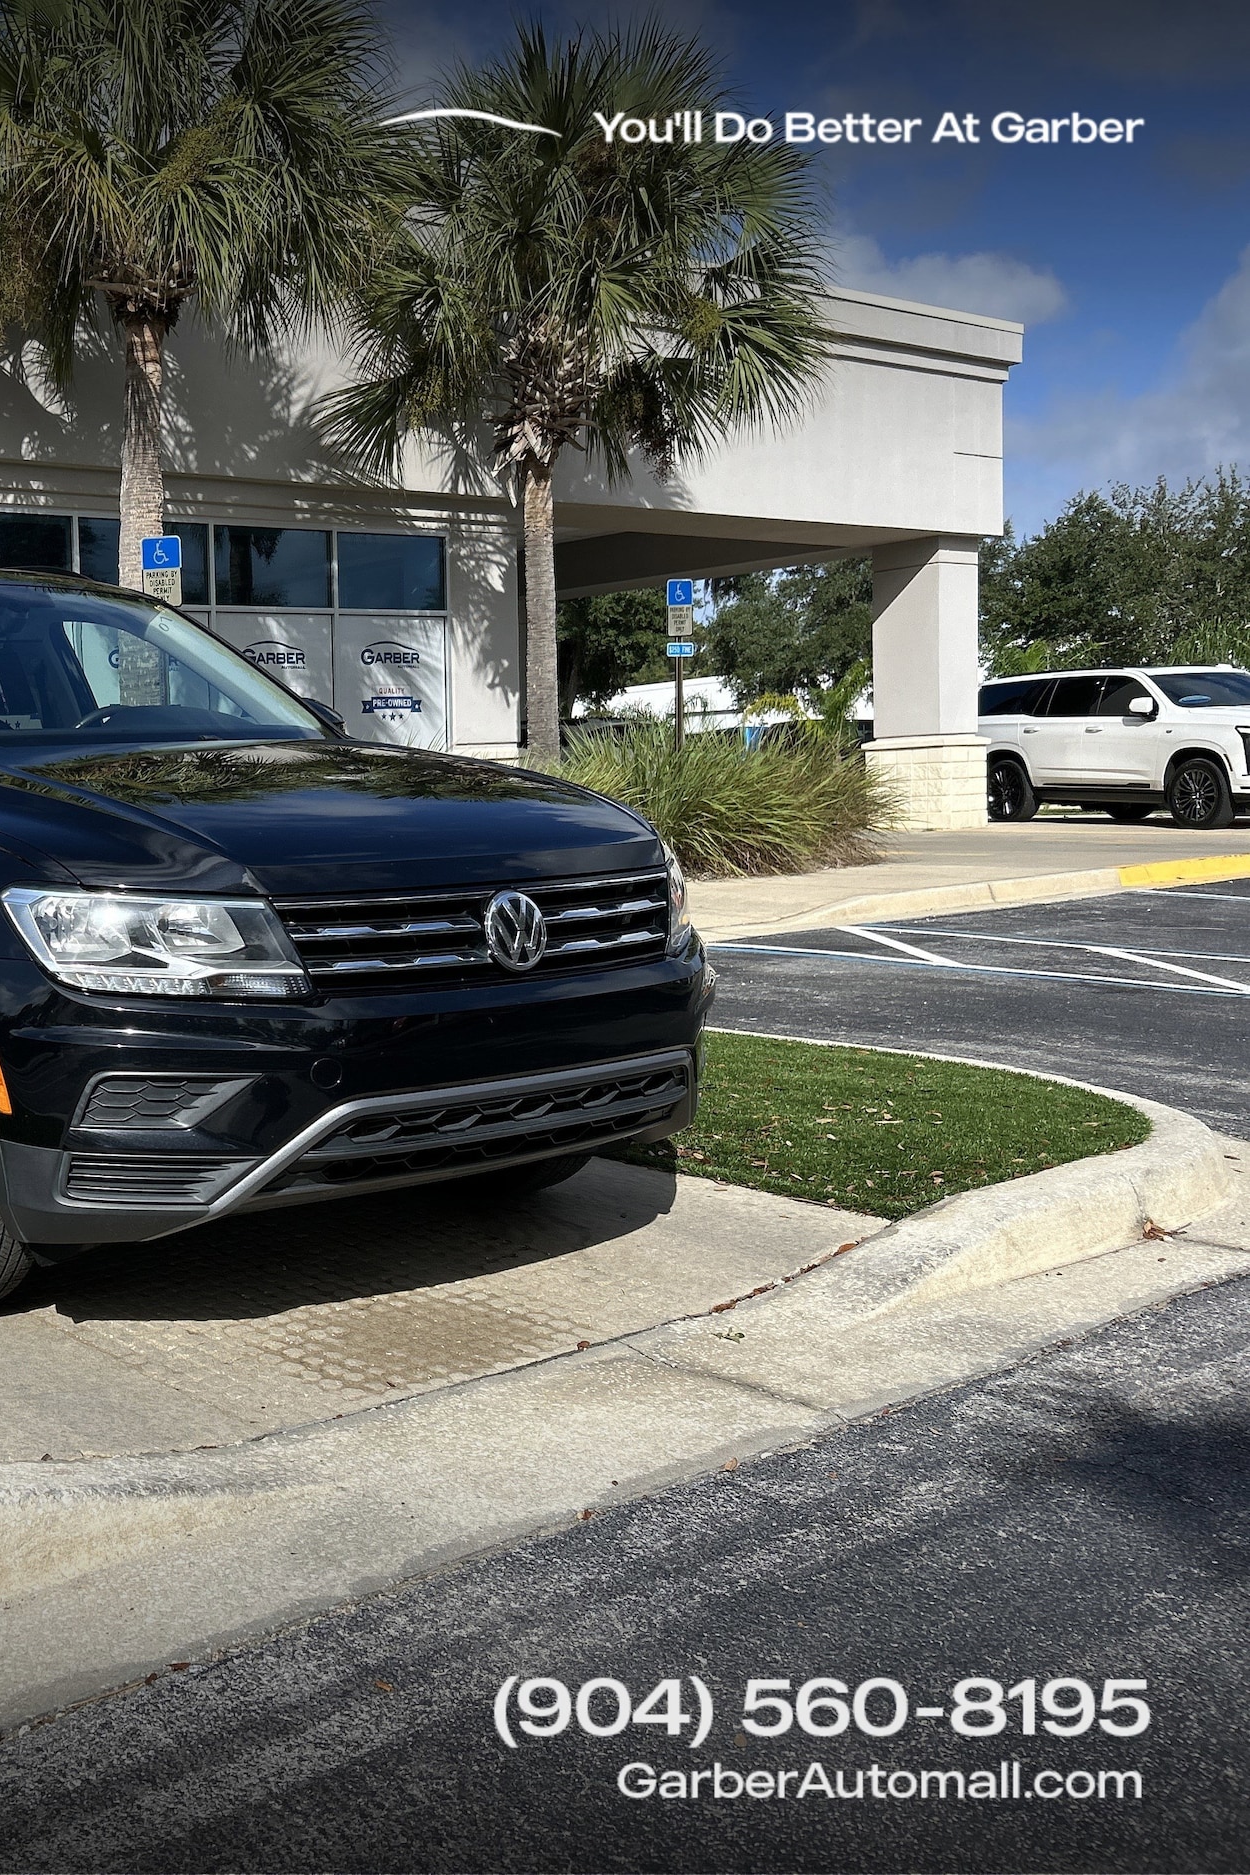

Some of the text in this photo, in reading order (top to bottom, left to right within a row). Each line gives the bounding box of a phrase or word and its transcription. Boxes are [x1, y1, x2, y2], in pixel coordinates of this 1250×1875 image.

[145, 570, 178, 579] PARKING BY
[149, 579, 176, 587] DISABLED
[152, 587, 172, 595] PERMIT
[360, 648, 420, 666] GARBER
[378, 687, 406, 695] QUALITY
[372, 698, 412, 708] PRE-OWNED
